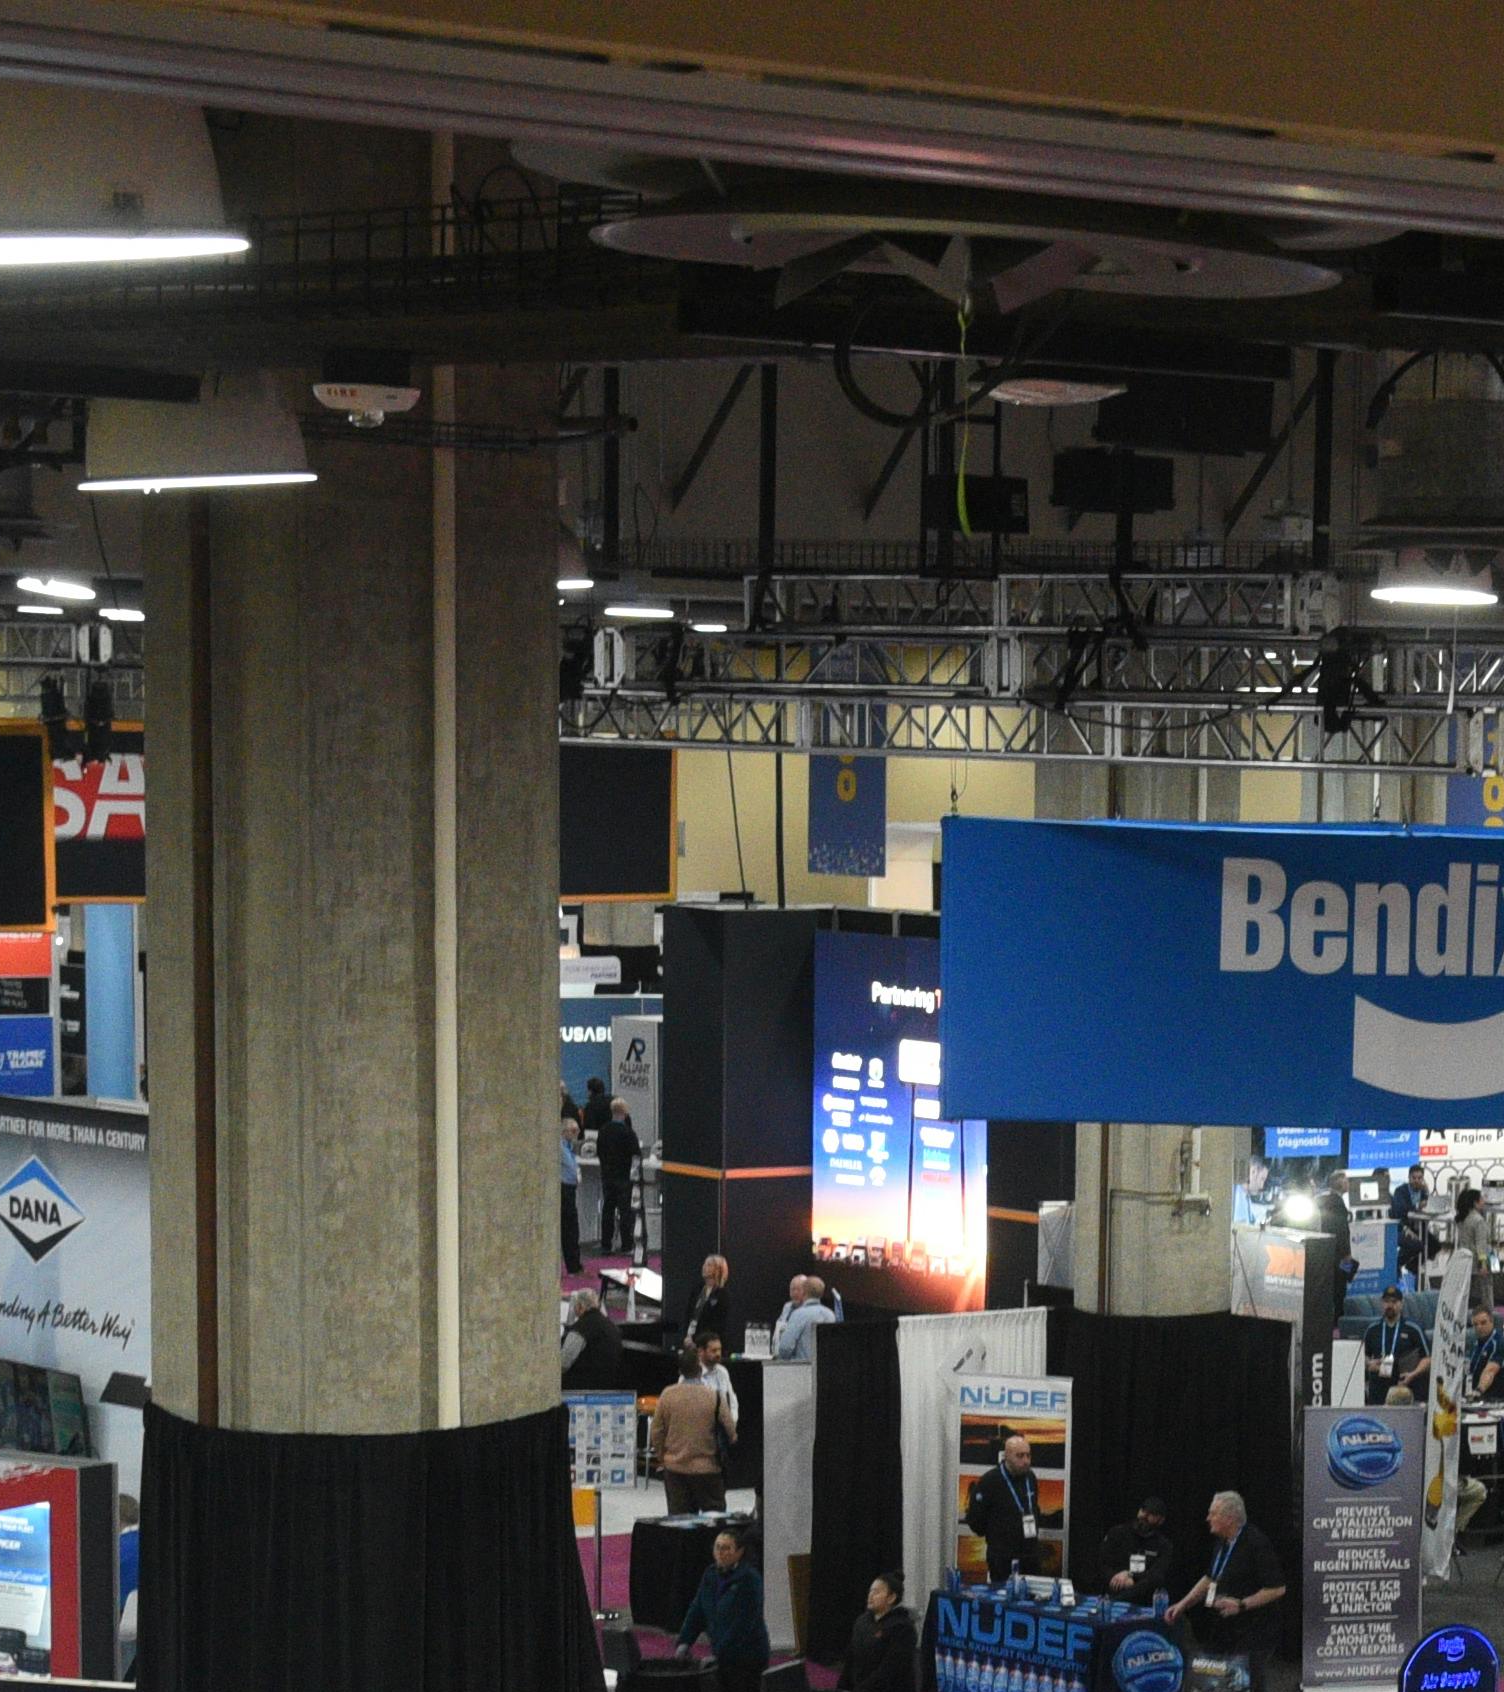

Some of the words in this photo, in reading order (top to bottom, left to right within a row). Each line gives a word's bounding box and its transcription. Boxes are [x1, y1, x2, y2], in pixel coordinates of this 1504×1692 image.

[28, 1119, 45, 1137] FOR
[47, 1123, 70, 1142] MORE
[73, 1126, 96, 1145] THAN
[97, 1129, 106, 1145] A
[106, 1131, 146, 1150] CENTURY
[1453, 1130, 1492, 1144] Engine
[1277, 1136, 1330, 1149] Diagnostics
[8, 1195, 62, 1227] DANA
[37, 1299, 52, 1329] A
[52, 1302, 99, 1336] Better
[98, 1312, 133, 1351] Way
[1335, 1507, 1391, 1518] PREVENTS
[1313, 1517, 1413, 1529] CRYSTALLIZATION
[1338, 1549, 1387, 1560] REDUCES
[1314, 1560, 1347, 1571] REGEN
[1349, 1559, 1411, 1571] INTERVALS
[1322, 1581, 1377, 1593] PROTECTS
[937, 1595, 1094, 1660] NÜDEF
[1330, 1624, 1363, 1635] SAVES
[1365, 1624, 1392, 1635] TIME
[1316, 1645, 1359, 1657] COSTLY
[1360, 1644, 1405, 1656] REPAIRS
